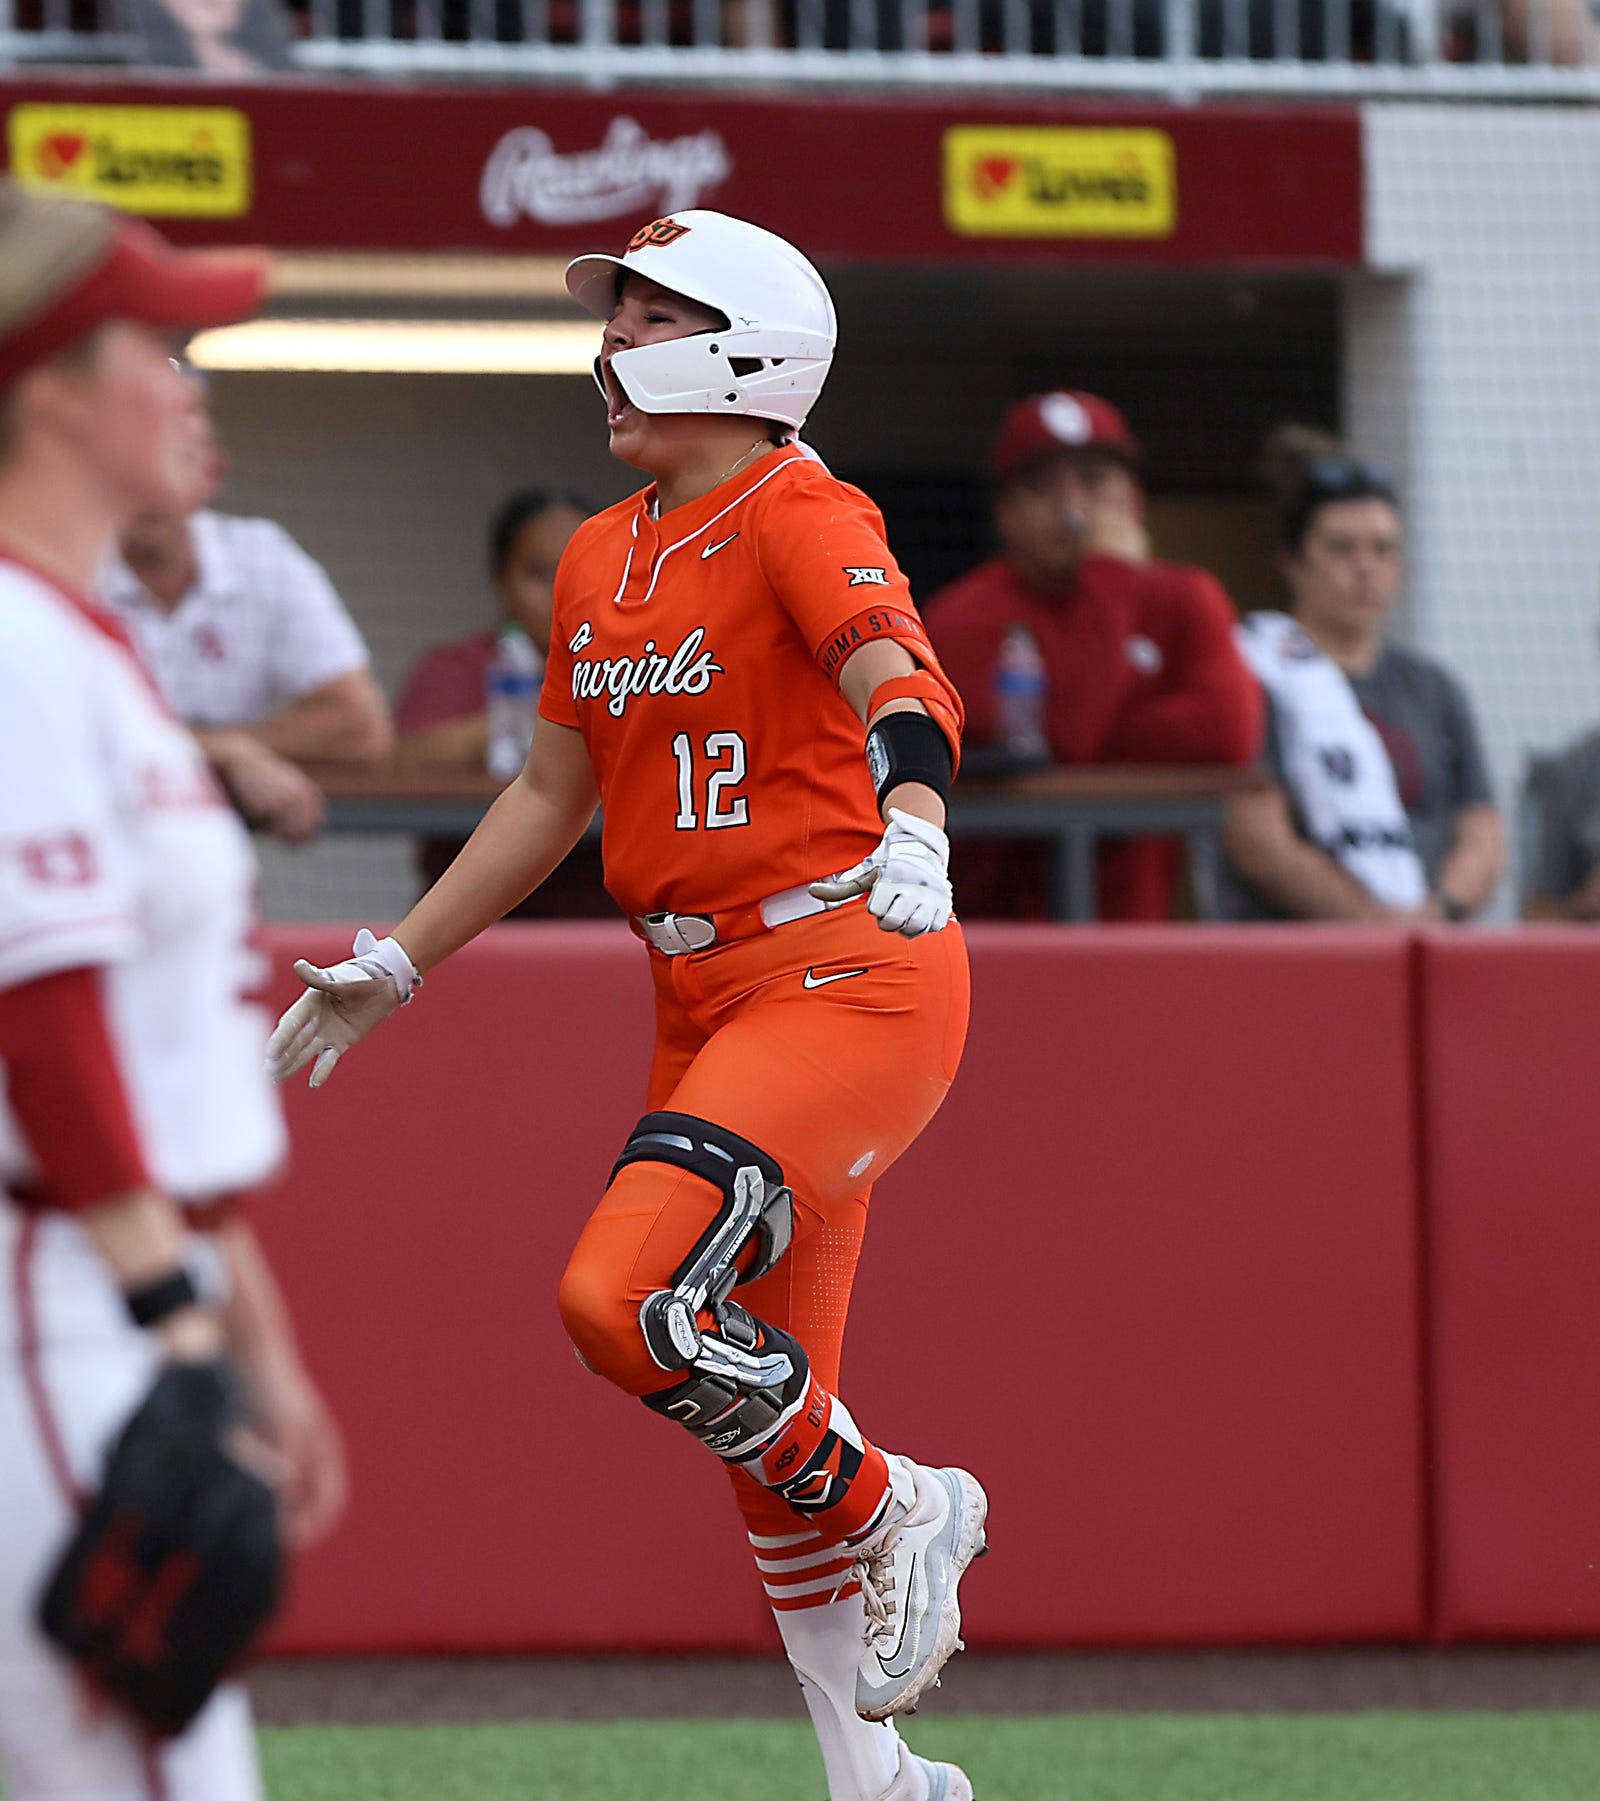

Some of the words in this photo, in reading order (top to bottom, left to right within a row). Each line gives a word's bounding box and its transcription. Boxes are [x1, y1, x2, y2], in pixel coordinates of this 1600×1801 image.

[480, 114, 734, 228] Rawlings
[625, 218, 692, 253] SU
[842, 567, 891, 587] XII
[670, 729, 751, 831] 12
[722, 1220, 754, 1263] TITANIUM
